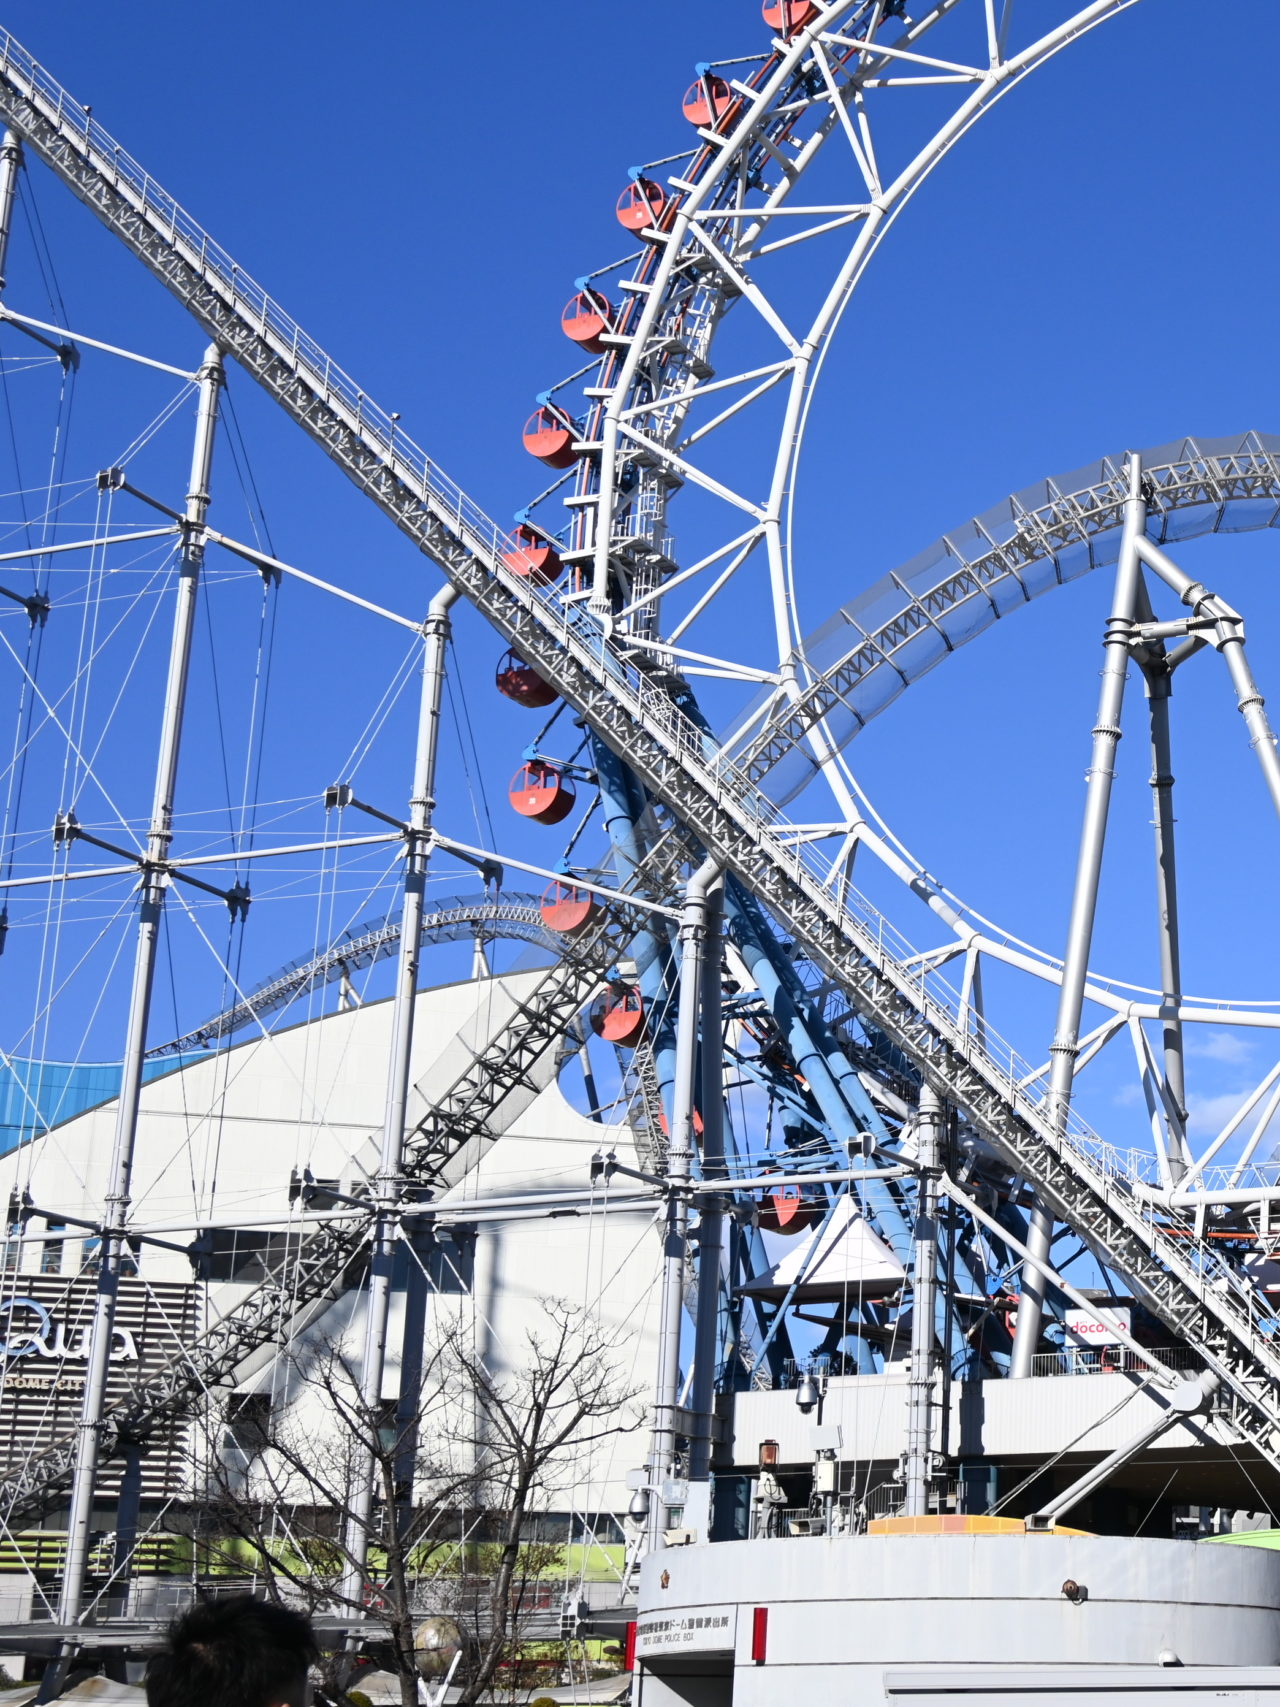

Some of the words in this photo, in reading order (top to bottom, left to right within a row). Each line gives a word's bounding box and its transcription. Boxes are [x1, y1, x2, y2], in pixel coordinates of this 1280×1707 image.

[1071, 1321, 1127, 1334] docoo
[4, 1377, 50, 1390] DOME
[56, 1379, 88, 1391] CIT
